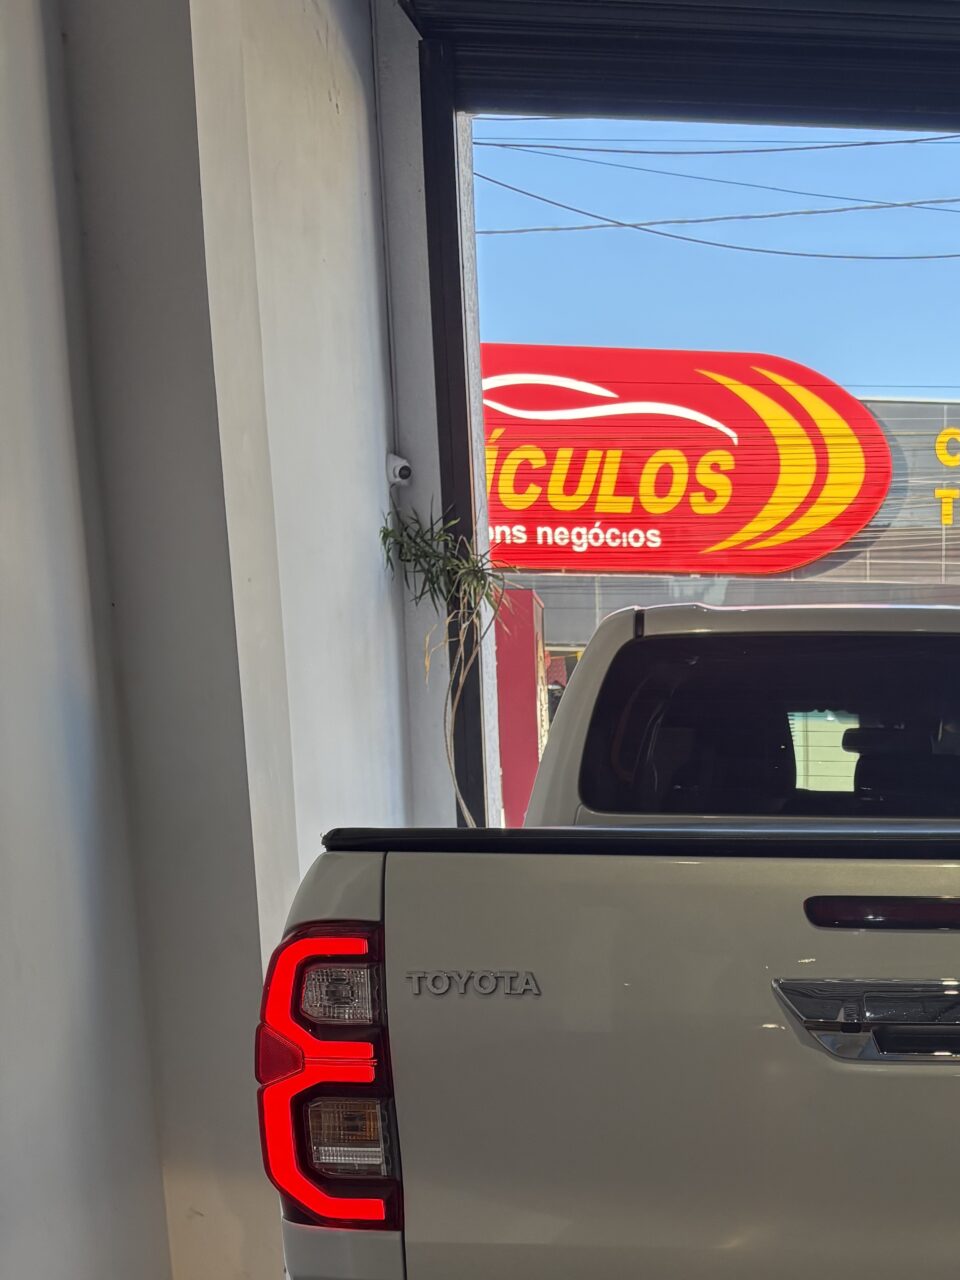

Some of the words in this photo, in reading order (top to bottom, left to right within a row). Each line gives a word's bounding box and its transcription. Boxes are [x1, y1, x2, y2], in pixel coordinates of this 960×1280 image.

[485, 427, 737, 516] ÍCULOS
[488, 525, 528, 544] ns
[536, 521, 662, 553] negócios
[405, 970, 542, 996] TOYOTA
